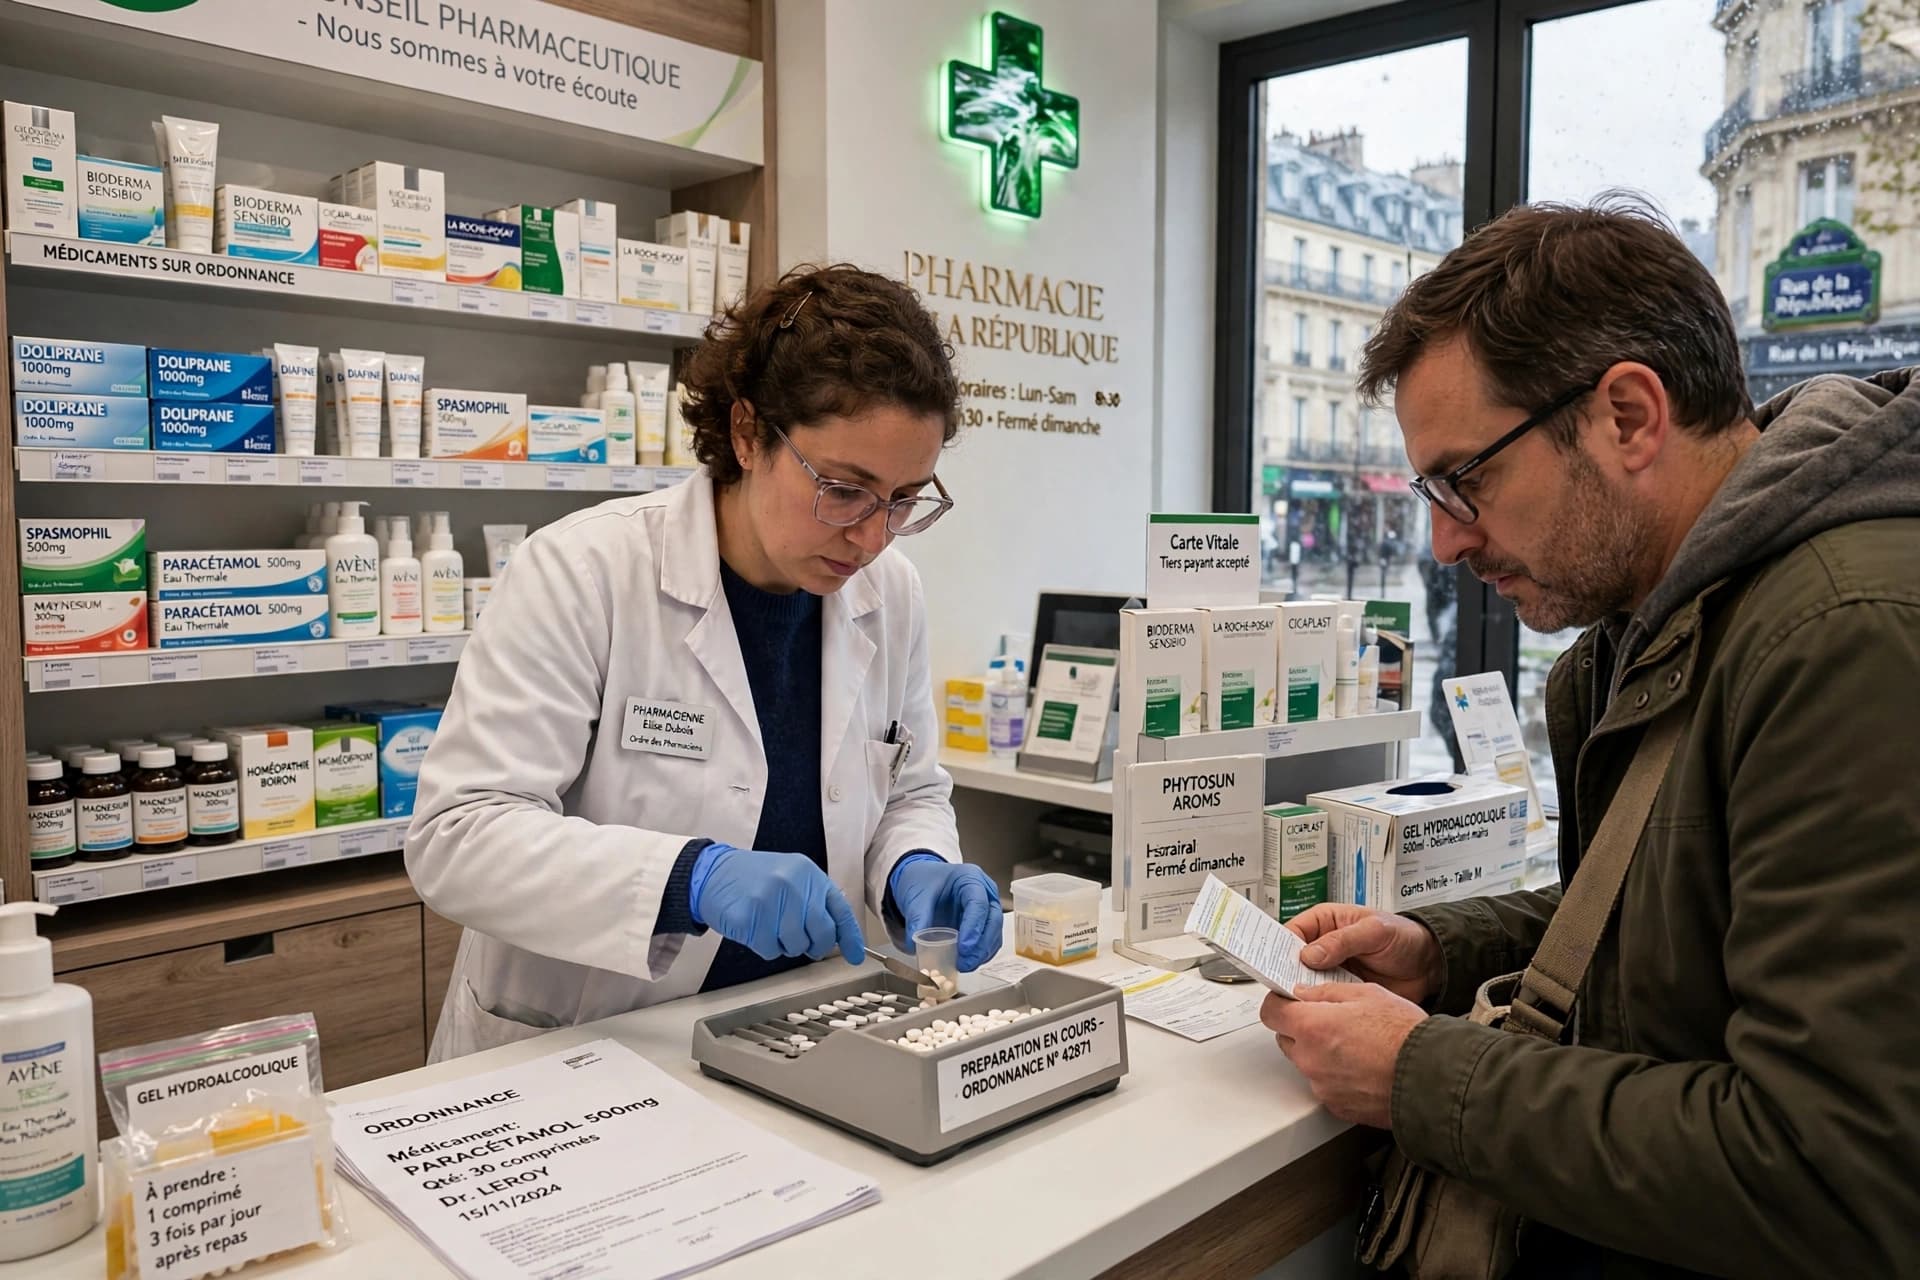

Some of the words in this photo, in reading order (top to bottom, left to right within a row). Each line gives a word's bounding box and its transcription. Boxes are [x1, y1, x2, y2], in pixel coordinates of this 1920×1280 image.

[439, 3, 681, 90] PHARMACEUTIQUE
[317, 12, 382, 50] Nous
[390, 37, 487, 75] sommes
[494, 56, 506, 79] à
[513, 64, 566, 93] votre
[572, 76, 638, 110] écoute
[87, 171, 152, 190] BIODERMA
[88, 185, 142, 202] SENSIBIO
[234, 195, 302, 216] BIODERMA
[234, 210, 291, 229] SENSIBIO
[447, 220, 457, 230] LA
[43, 243, 158, 270] MÉDICAMENTS
[162, 259, 191, 275] SUR
[195, 261, 296, 286] ORDONNANCE
[904, 250, 1104, 322] PHARMACIE
[971, 314, 1119, 365] RÉPUBLIQUE
[20, 344, 103, 362] DOLIPRANE
[22, 361, 71, 378] 1000mg
[158, 355, 232, 373] DOLIPRANE
[158, 370, 204, 387] 1000mg
[957, 379, 1007, 400] oraires
[1018, 383, 1077, 406] Lun-Sam
[23, 400, 105, 416] DOLIPRANE
[161, 406, 234, 423] DOLIPRANE
[437, 398, 510, 415] SPASMOPHIL
[25, 416, 74, 432] 1000mg
[161, 421, 207, 438] 1000mg
[997, 410, 1038, 431] Fermé
[1041, 413, 1101, 436] dimanche
[26, 527, 112, 540] SPASMOPHIL
[1170, 534, 1204, 551] Carte
[1205, 533, 1240, 550] Vitale
[26, 541, 66, 555] 500mg
[163, 555, 260, 570] PARACÉTAMOL
[267, 557, 301, 570] 500mg
[1159, 556, 1182, 569] Tiers
[1183, 557, 1215, 573] payant
[1215, 554, 1250, 572] accepté
[163, 573, 182, 583] Eau
[185, 571, 228, 583] Thermale
[164, 602, 262, 619] PARACÉTAMOL
[268, 603, 302, 615] 500mg
[164, 622, 183, 632] Eau
[186, 620, 229, 631] Thermale
[1147, 623, 1195, 638] BIODERMA
[1213, 622, 1223, 633] LA
[1288, 616, 1332, 629] CICAPLAST
[247, 759, 310, 777] HOMÉOPATHIE
[260, 775, 297, 788] BOIRON
[1163, 772, 1235, 794] PHYTOSUN
[1172, 792, 1221, 811] AROMS
[1403, 824, 1421, 839] GEL
[1424, 806, 1506, 836] HYDROALCOOLIQUE
[1146, 859, 1186, 878] Fermé
[1189, 852, 1245, 873] dimanche
[960, 1037, 1041, 1079] PREPARATION
[1043, 1032, 1059, 1048] EN
[1060, 1017, 1097, 1043] COURS
[7, 1060, 63, 1085] AVÈNE
[962, 1058, 1044, 1099] ORDONNANCE
[1046, 1051, 1059, 1069] N°
[1062, 1039, 1092, 1063] 42871
[137, 1088, 165, 1105] GEL
[167, 1056, 299, 1098] HYDROALCOOLIQUE
[364, 1089, 521, 1135] ORDONNANCE
[387, 1120, 521, 1163] Médicament:
[403, 1119, 584, 1176] PARACÉTAMOL
[583, 1096, 660, 1124] 500mg
[422, 1170, 468, 1191] Qté:
[469, 1163, 496, 1178] 30
[500, 1132, 601, 1169] comprimés
[146, 1181, 159, 1201] À
[163, 1167, 226, 1199] prendre
[438, 1190, 476, 1208] Dr.
[478, 1166, 551, 1197] LEROY
[147, 1208, 156, 1223] 1
[163, 1184, 243, 1221] comprimé
[458, 1183, 562, 1222] 15/11/2024
[150, 1230, 160, 1247] 3
[165, 1220, 196, 1244] fois
[200, 1216, 226, 1236] par
[230, 1203, 262, 1228] jour
[155, 1240, 200, 1270] après
[205, 1230, 249, 1254] repas
